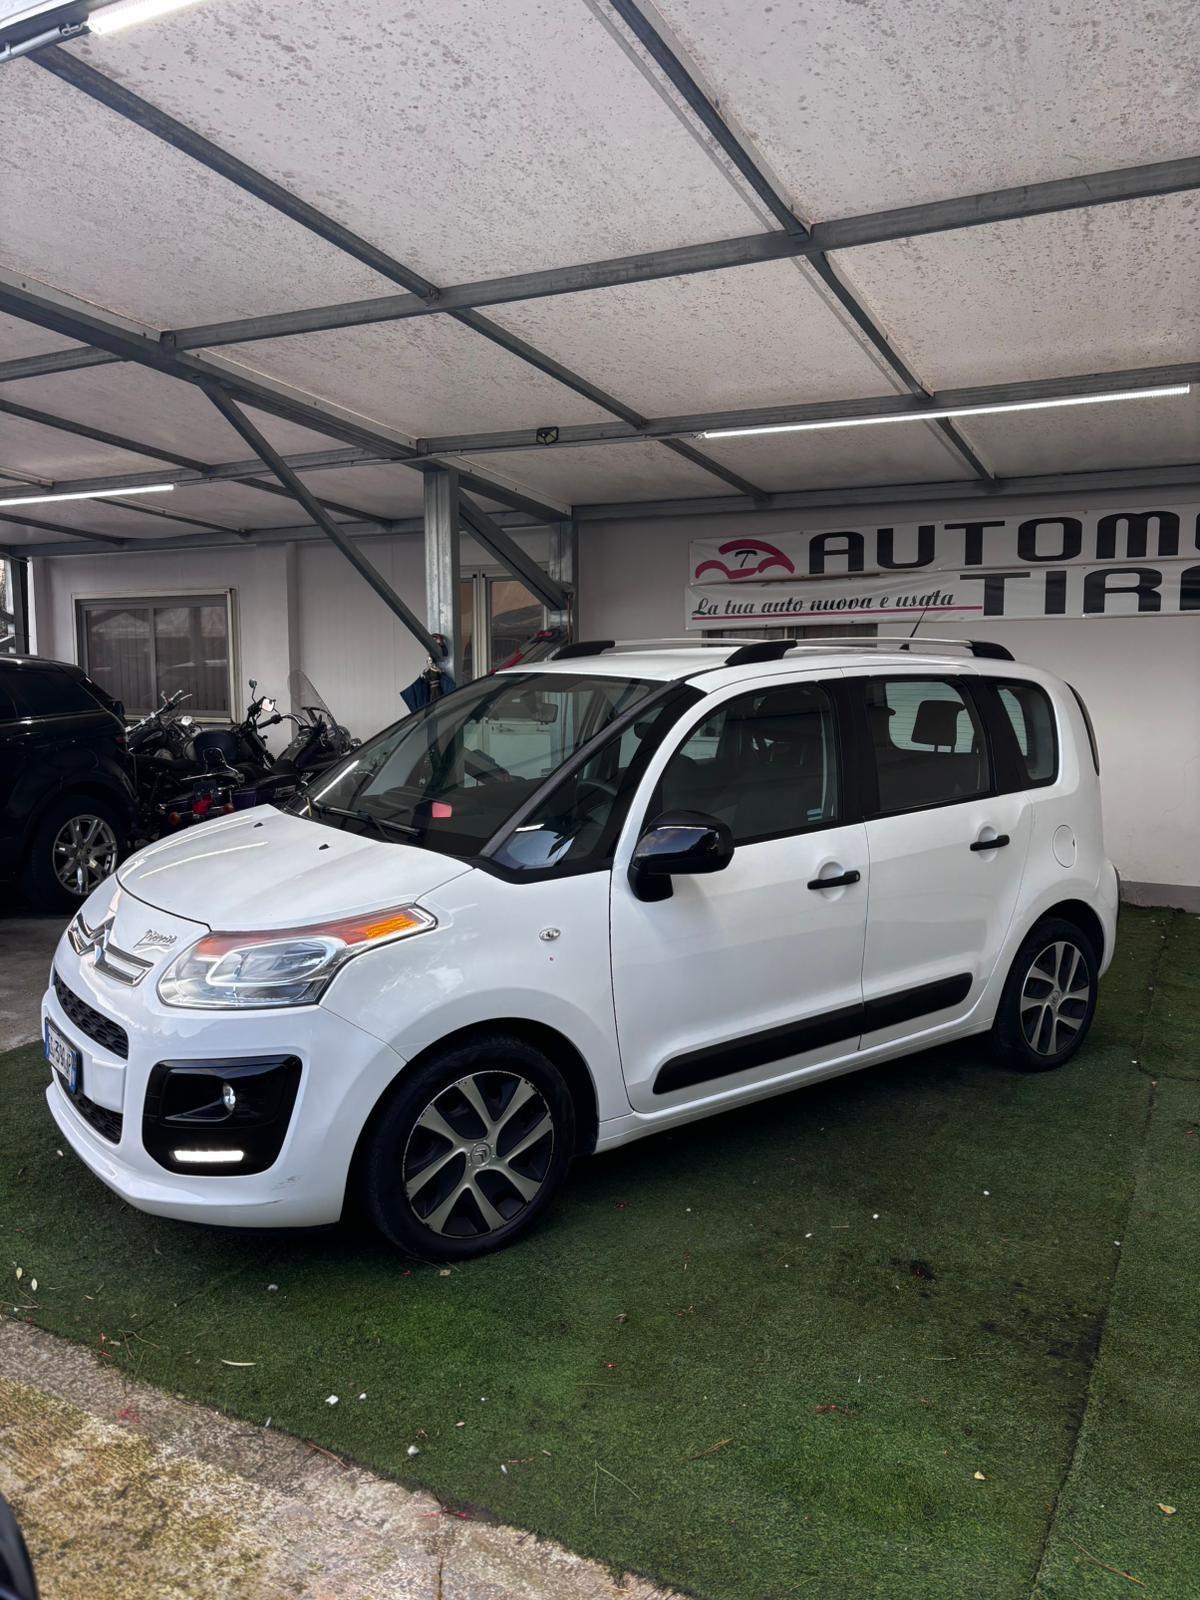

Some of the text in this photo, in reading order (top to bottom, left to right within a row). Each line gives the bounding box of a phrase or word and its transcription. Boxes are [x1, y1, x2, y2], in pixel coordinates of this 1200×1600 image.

[808, 510, 1200, 574] AUTOM
[692, 589, 955, 615] La tua auto nuova e usata
[959, 565, 1200, 617] TIR
